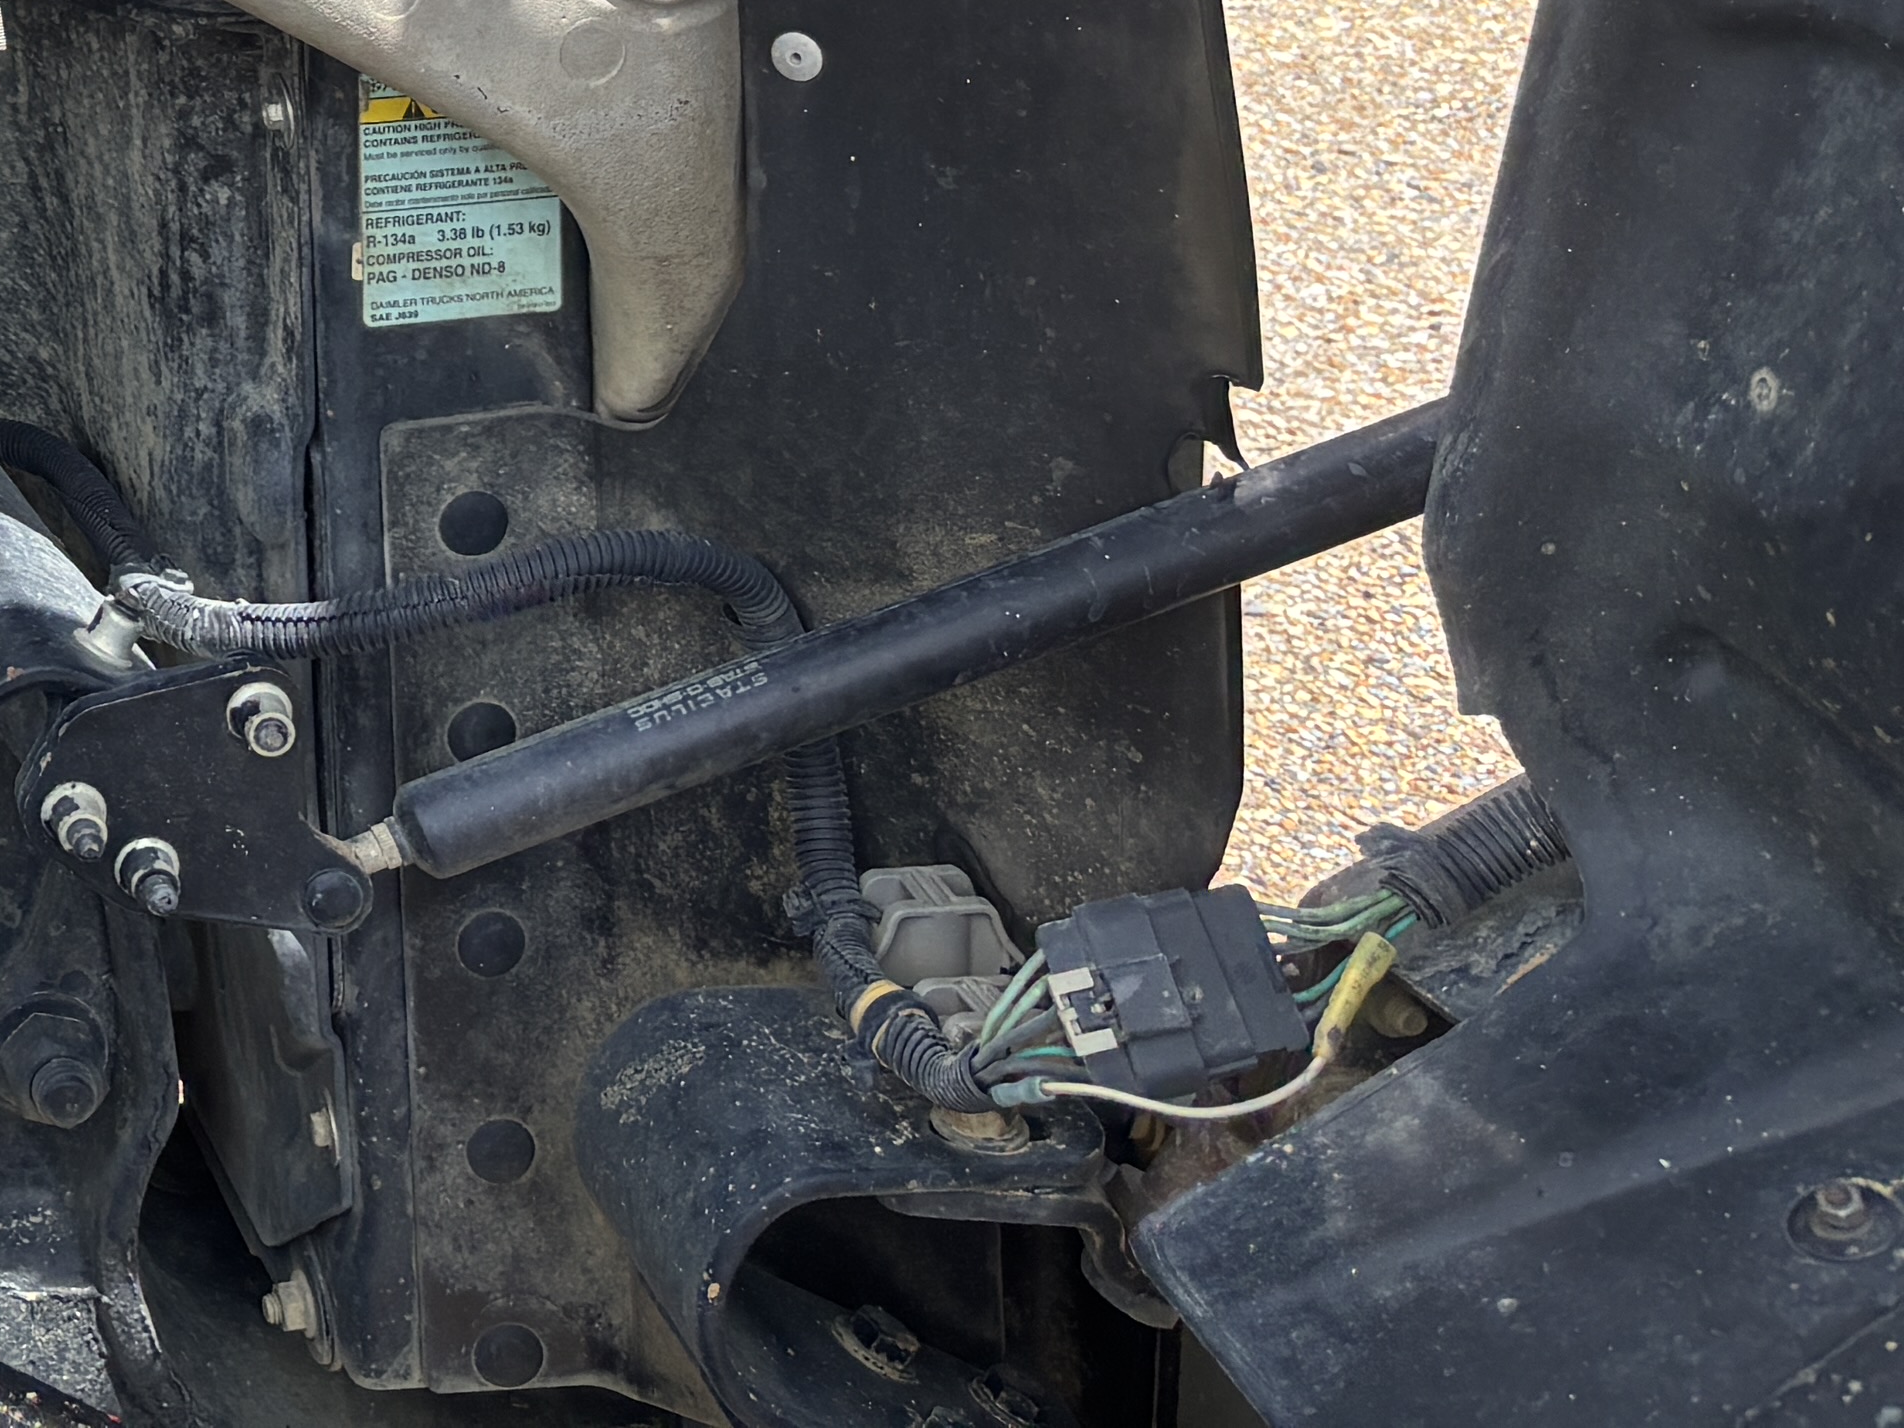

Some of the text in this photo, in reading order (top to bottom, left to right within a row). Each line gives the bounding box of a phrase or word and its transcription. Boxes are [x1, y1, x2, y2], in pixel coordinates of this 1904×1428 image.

[363, 125, 411, 136] CAUTION
[414, 122, 441, 131] HIGH
[363, 136, 418, 148] CONTAINS
[400, 148, 437, 158] serviced
[429, 166, 471, 179] SISTEMA
[474, 165, 481, 174] A
[484, 163, 506, 173] ALTA
[364, 176, 514, 196] CONTIENE REFRIGERANTE 134a
[365, 211, 466, 230] REFRIGERANT:
[367, 220, 551, 248] R-134a 3.38 lb (1.53 kg)
[366, 246, 494, 266] COMPRESSOR OIL:
[367, 270, 398, 284] PAG
[411, 264, 465, 281] DENSO
[470, 261, 506, 276] ND-8
[370, 286, 555, 310] DAIMLER TRUCKS NORTH AMERICA
[370, 313, 393, 322] SAE
